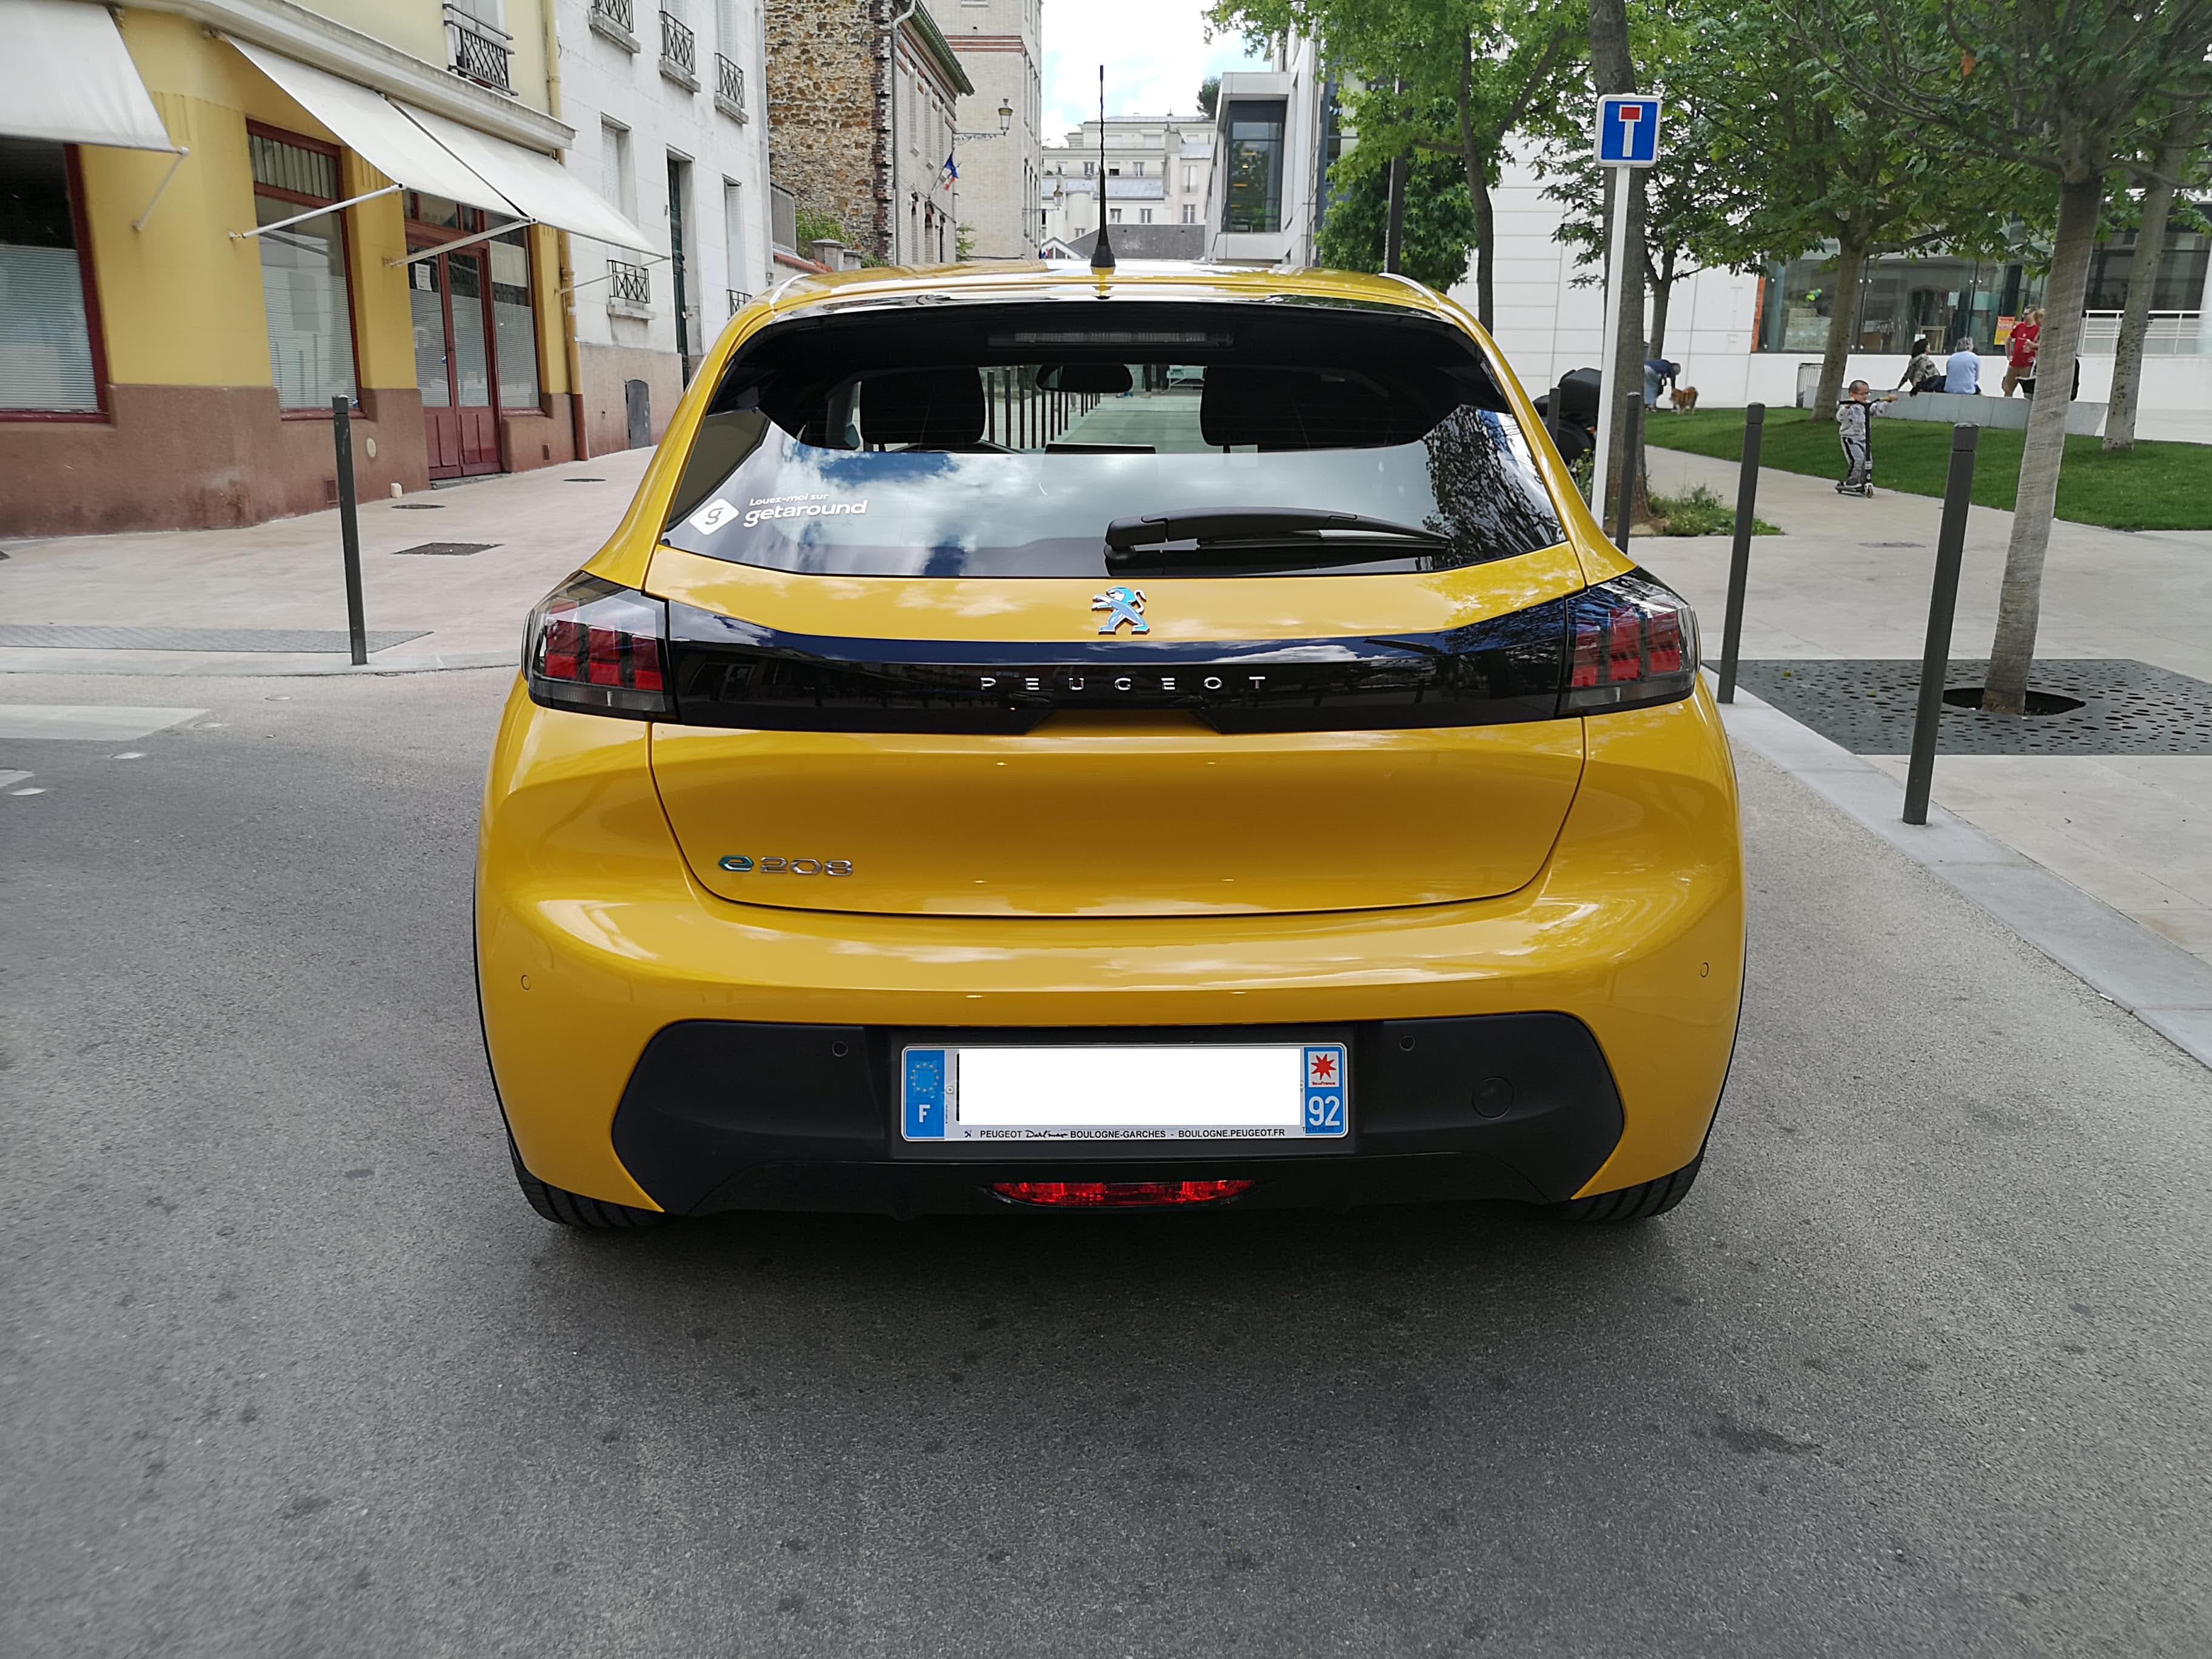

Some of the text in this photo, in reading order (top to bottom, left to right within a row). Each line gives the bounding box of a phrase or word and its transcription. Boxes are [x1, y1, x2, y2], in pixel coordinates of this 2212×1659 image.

[749, 493, 809, 506] Louez-moi
[743, 500, 869, 528] getaround
[979, 676, 1266, 691] PEUGEOT
[919, 1104, 931, 1123] F
[1309, 1095, 1341, 1127] 92
[979, 1130, 1023, 1139] PEUGEOT
[1070, 1130, 1167, 1139] BOULOGNE-GARCHES
[1178, 1129, 1286, 1138] BOULOGNE.PEUGEOT.FR
